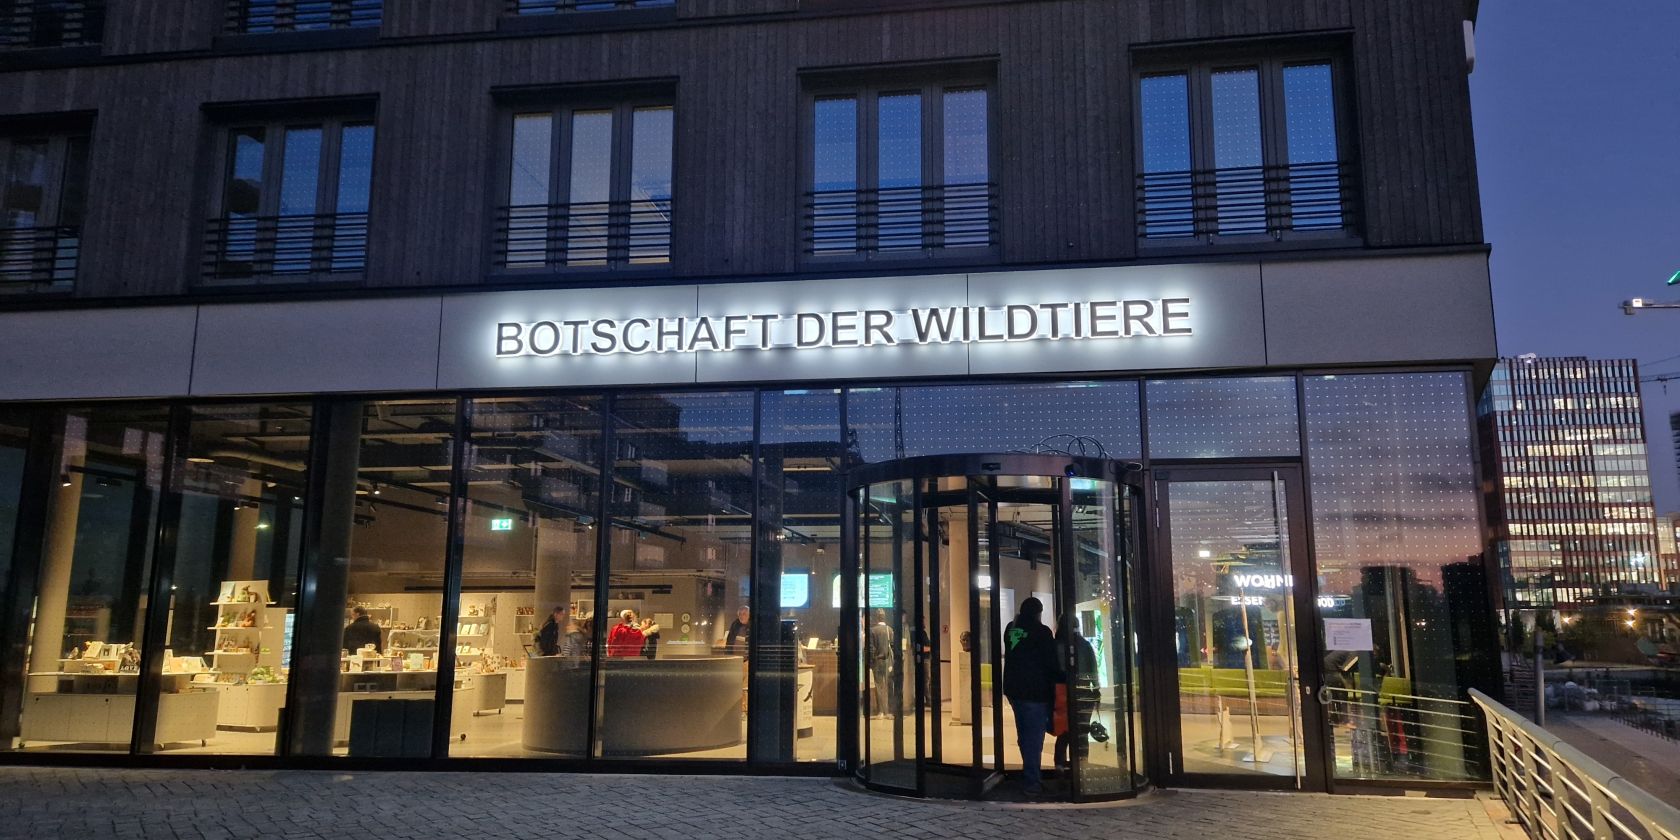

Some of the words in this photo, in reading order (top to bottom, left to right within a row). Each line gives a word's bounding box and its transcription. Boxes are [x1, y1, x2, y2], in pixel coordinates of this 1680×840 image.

[496, 314, 779, 356] BOTSCHAFT
[796, 310, 895, 348] DER
[911, 298, 1192, 342] WILDTIERE
